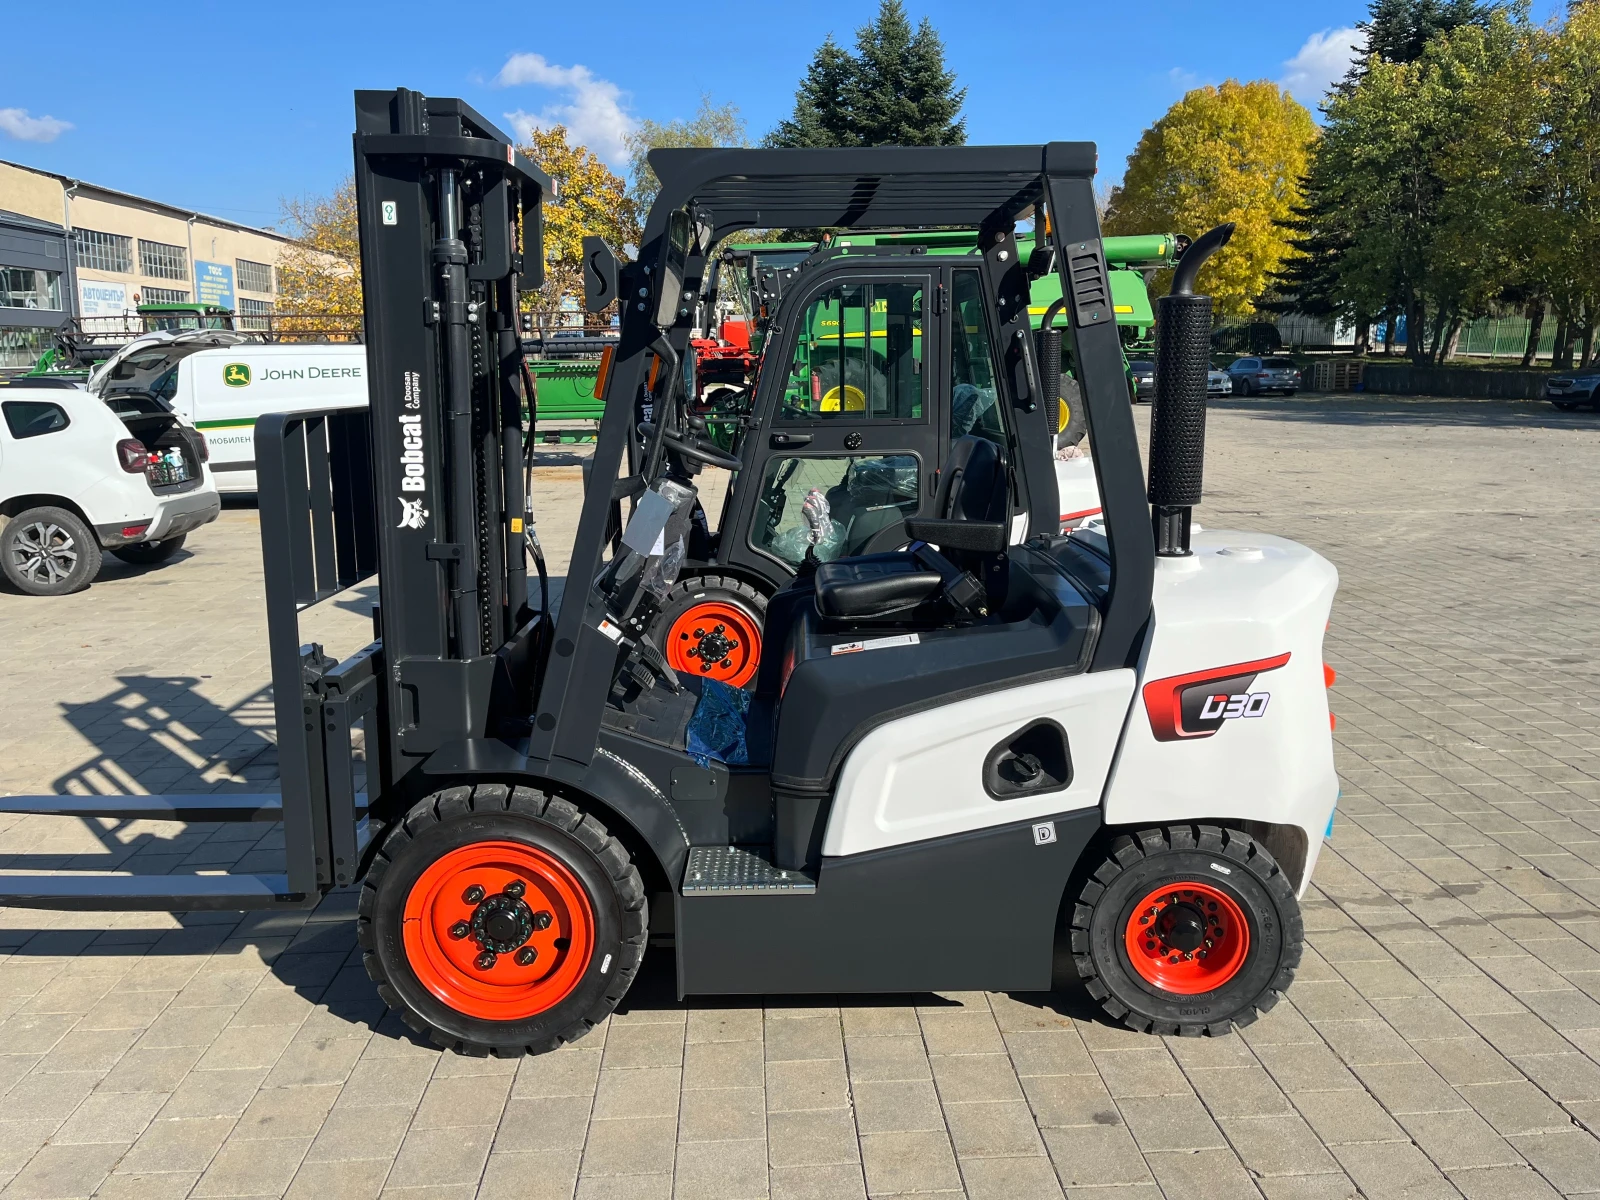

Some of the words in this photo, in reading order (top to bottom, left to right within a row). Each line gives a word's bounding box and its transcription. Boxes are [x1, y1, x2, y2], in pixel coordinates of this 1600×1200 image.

[83, 287, 125, 302] АВТОЦЕНТЪР
[404, 371, 412, 401] Doosan
[411, 371, 421, 409] Company
[209, 436, 251, 445] МОБИЛЕН
[398, 414, 426, 491] Bobcat
[1199, 692, 1270, 719] D30
